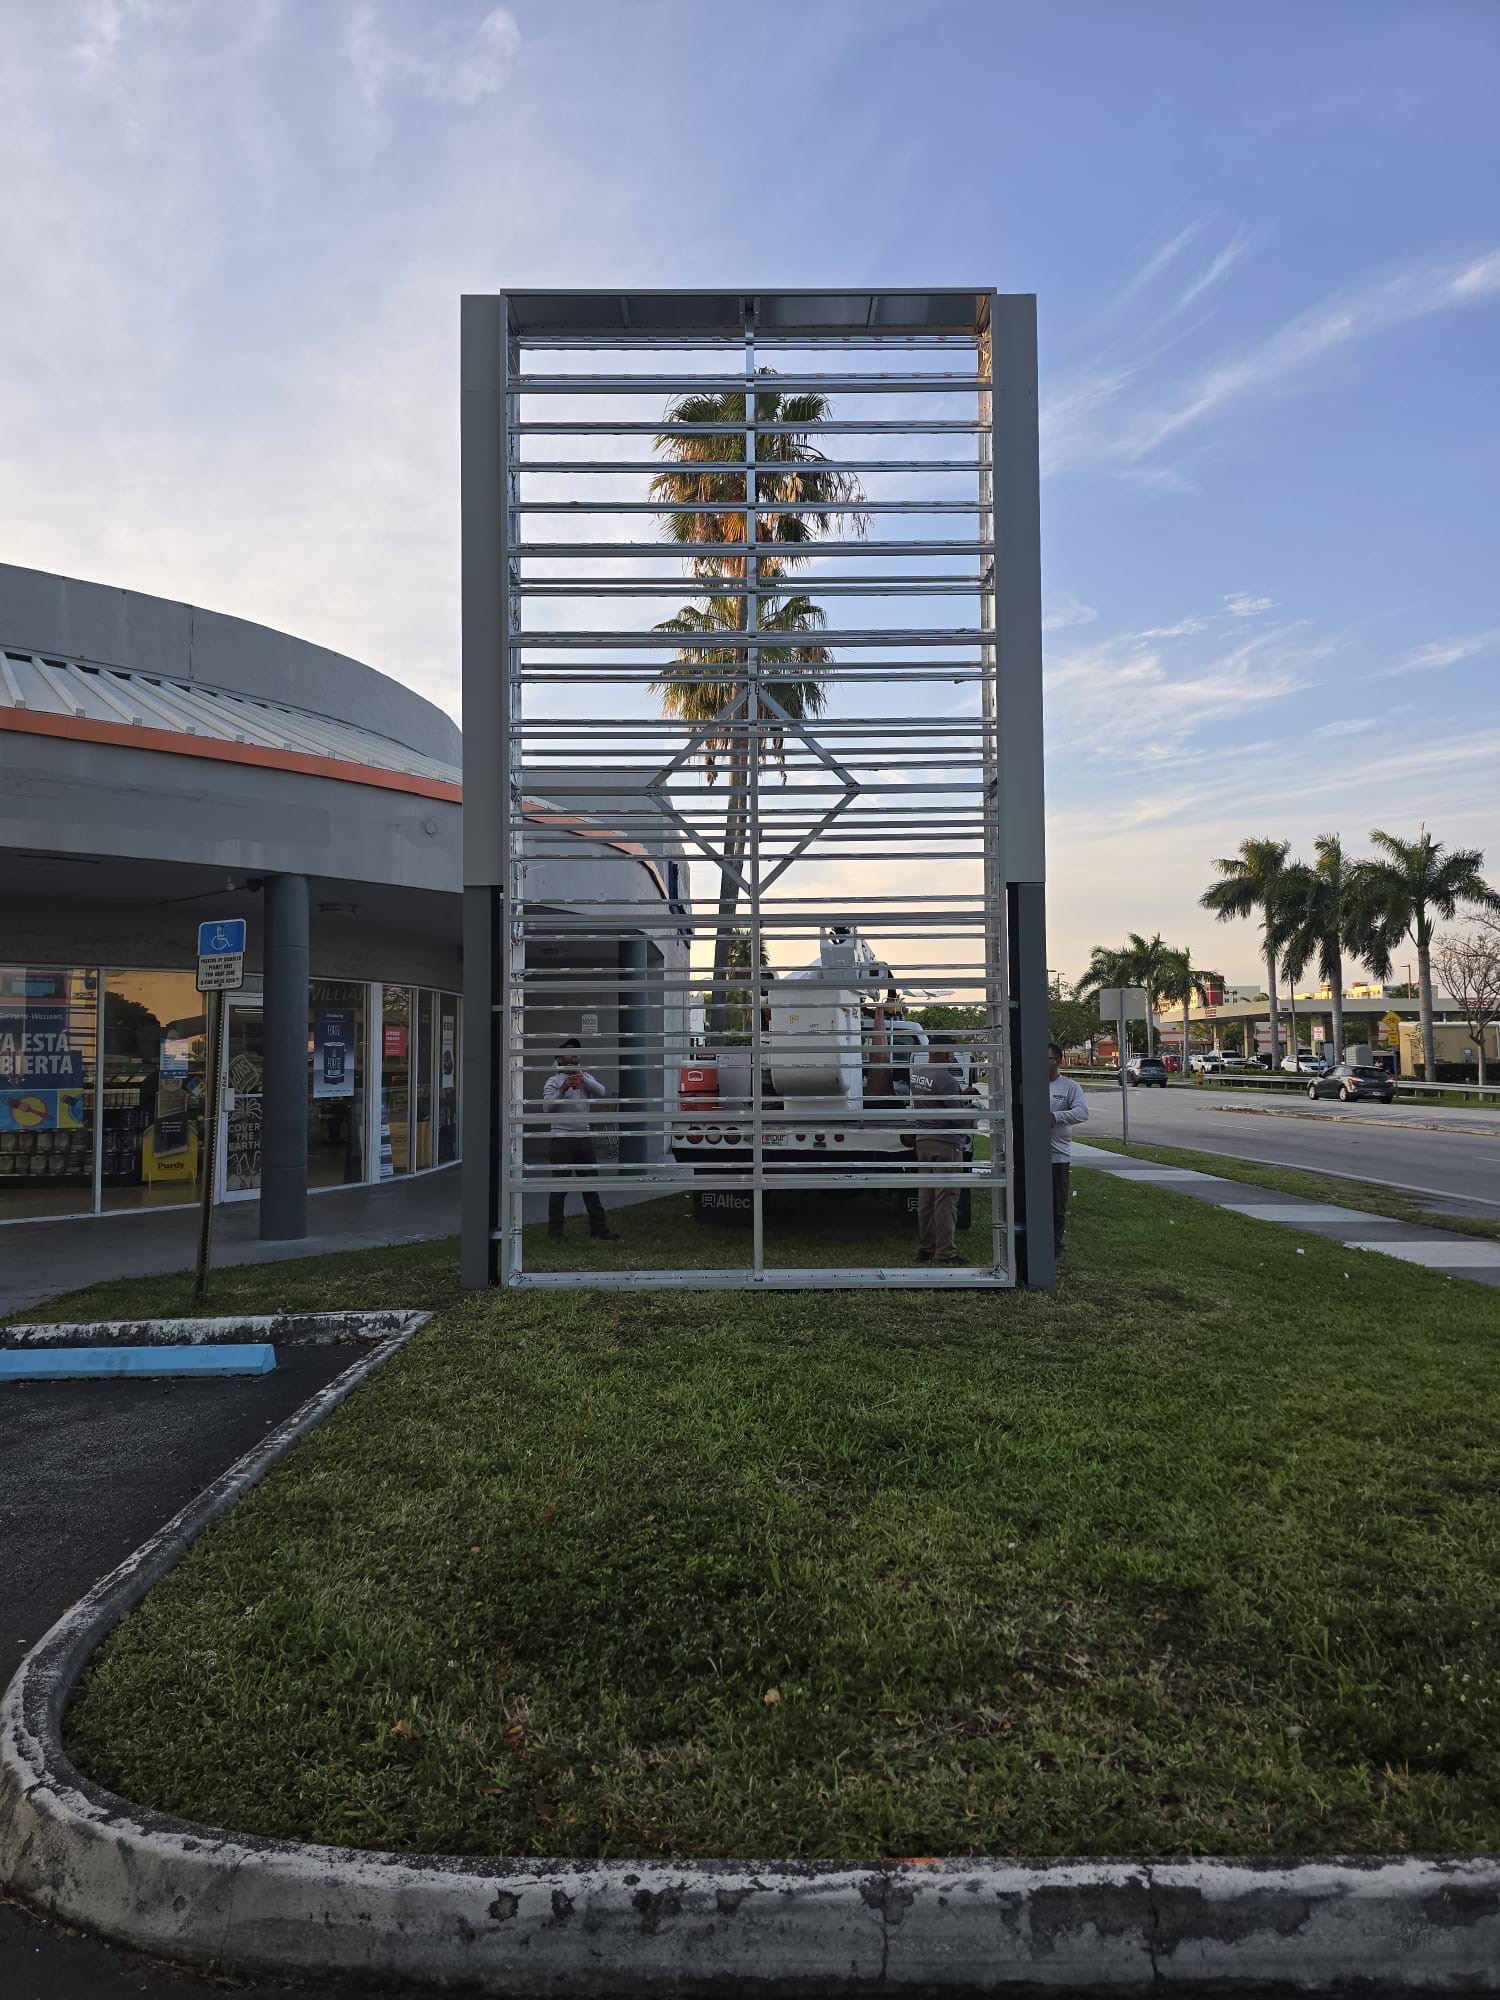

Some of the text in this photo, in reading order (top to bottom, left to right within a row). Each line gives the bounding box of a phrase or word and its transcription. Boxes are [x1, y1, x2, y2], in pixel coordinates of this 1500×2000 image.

[21, 1029, 69, 1052] ESTÁ
[911, 1074, 934, 1088] SIGN
[228, 1122, 261, 1133] COVER
[235, 1133, 255, 1141] THE
[228, 1141, 261, 1150] EARTH
[157, 1161, 185, 1170] Purdy
[716, 1194, 751, 1209] Altec
